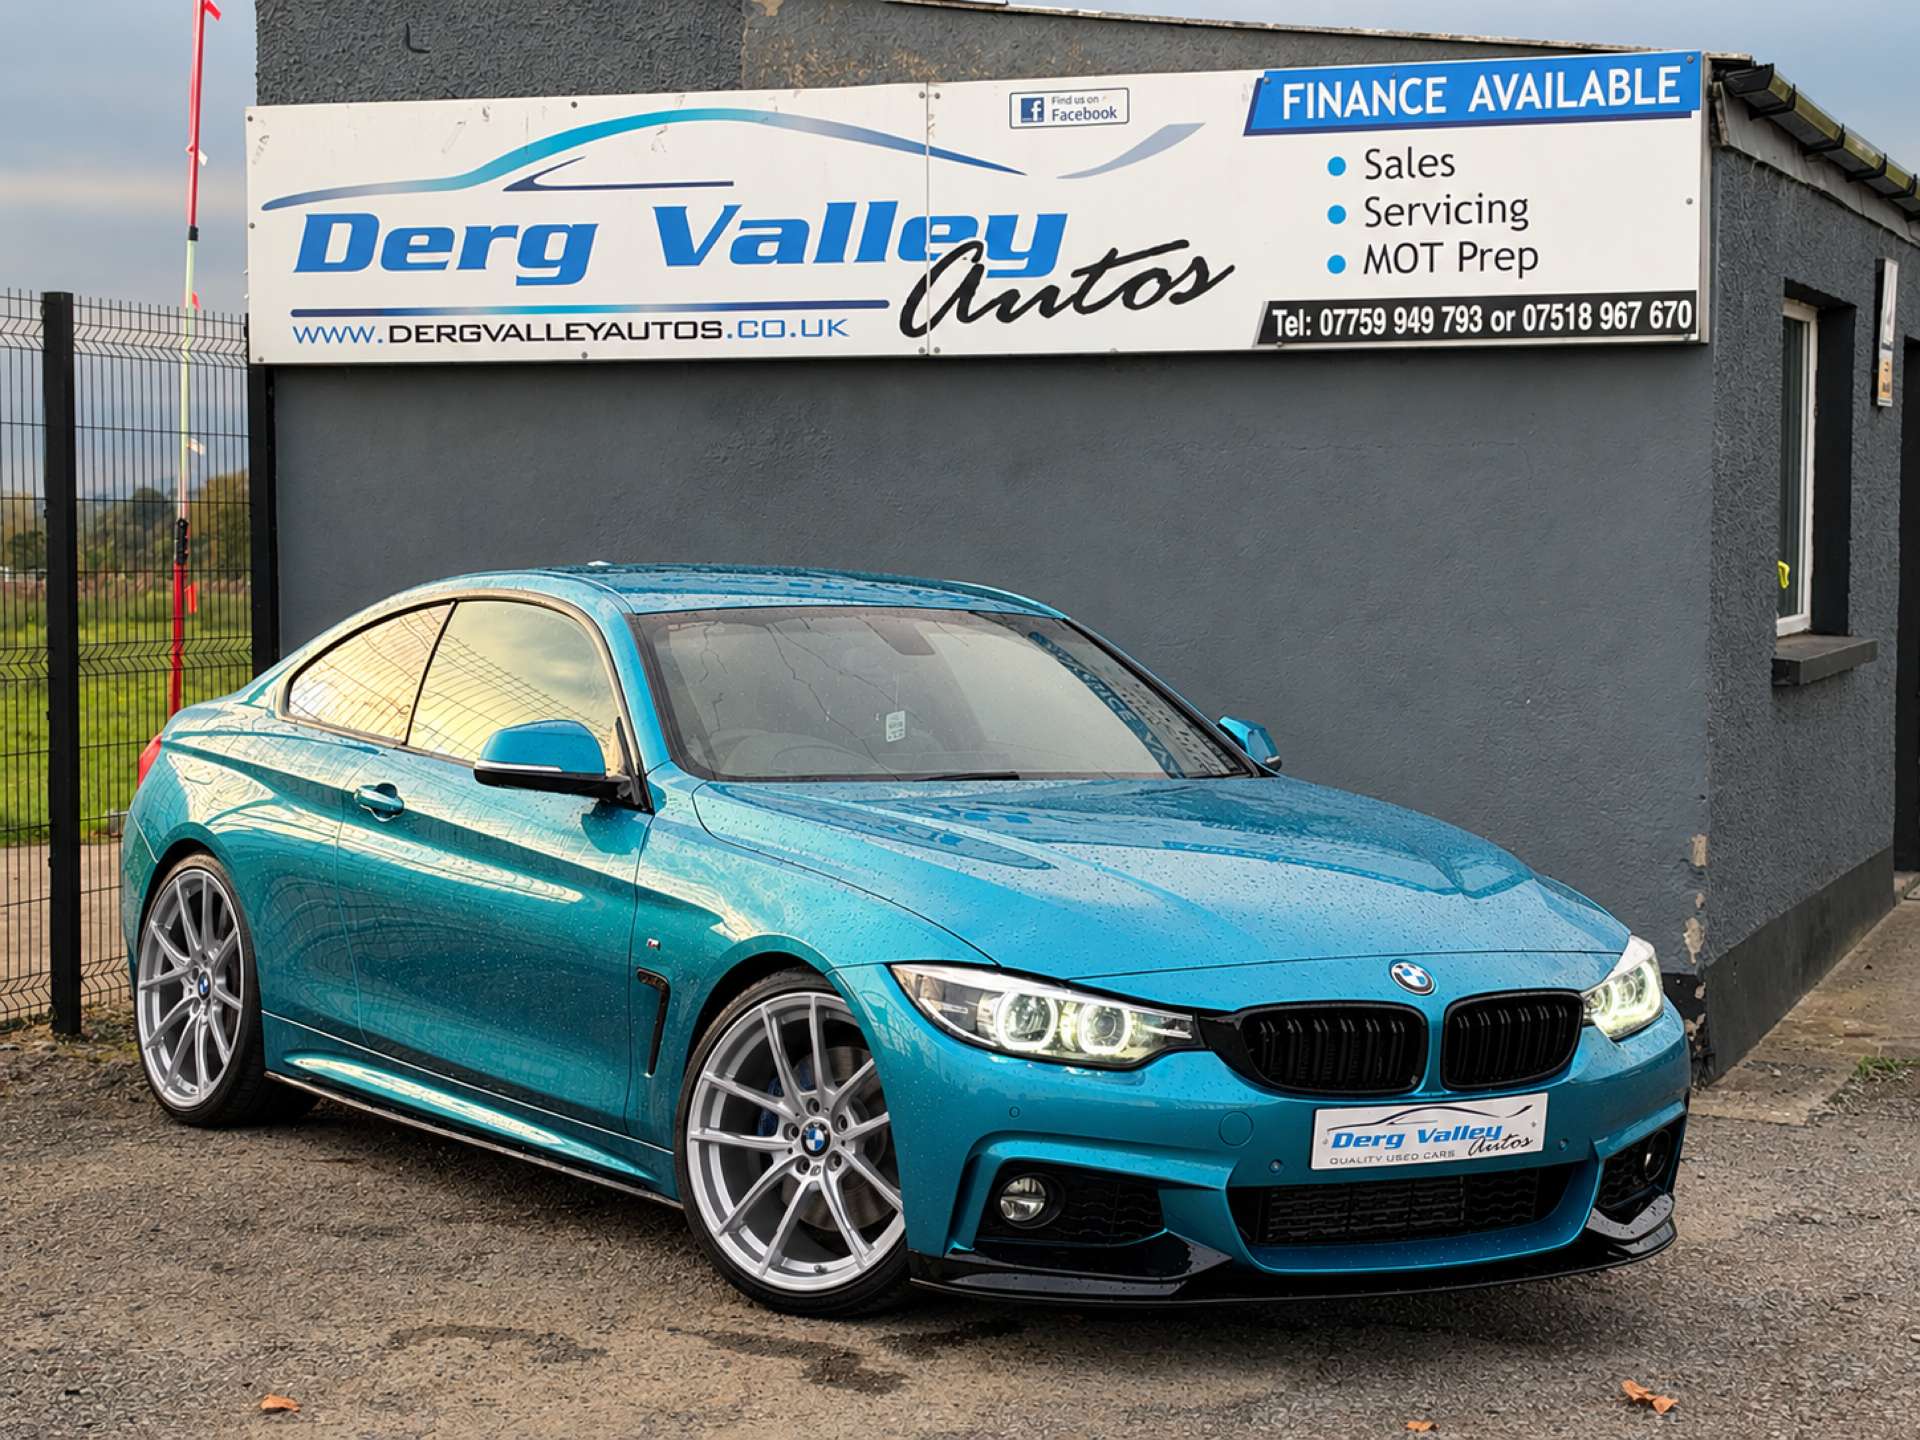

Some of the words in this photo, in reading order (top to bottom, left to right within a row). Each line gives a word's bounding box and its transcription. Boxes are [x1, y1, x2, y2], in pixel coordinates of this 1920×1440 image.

[1051, 96, 1072, 105] Find
[1074, 97, 1086, 105] us
[1087, 96, 1100, 104] on
[1283, 77, 1447, 120] FINANCE
[1468, 65, 1681, 112] AVAILABLE
[1052, 105, 1118, 121] Facebook
[1365, 146, 1456, 180] Sales
[1364, 192, 1529, 232] Servicing
[293, 212, 599, 287] Derg
[653, 200, 1068, 279] Valley
[1363, 242, 1444, 275] MOT
[1458, 240, 1539, 280] Prep
[1272, 308, 1312, 337] Tel:
[1320, 307, 1387, 336] 07759
[1393, 305, 1434, 335] 949
[1441, 304, 1483, 334] 793
[1490, 307, 1516, 333] or
[1522, 302, 1592, 332] 07518
[1599, 300, 1642, 330] 967
[1649, 300, 1692, 329] 670
[1331, 1131, 1405, 1150] Derg
[1418, 1125, 1504, 1143] Valley
[1329, 1155, 1384, 1166] QUALITY
[1386, 1152, 1419, 1163] USED
[1423, 1150, 1456, 1160] CARS
